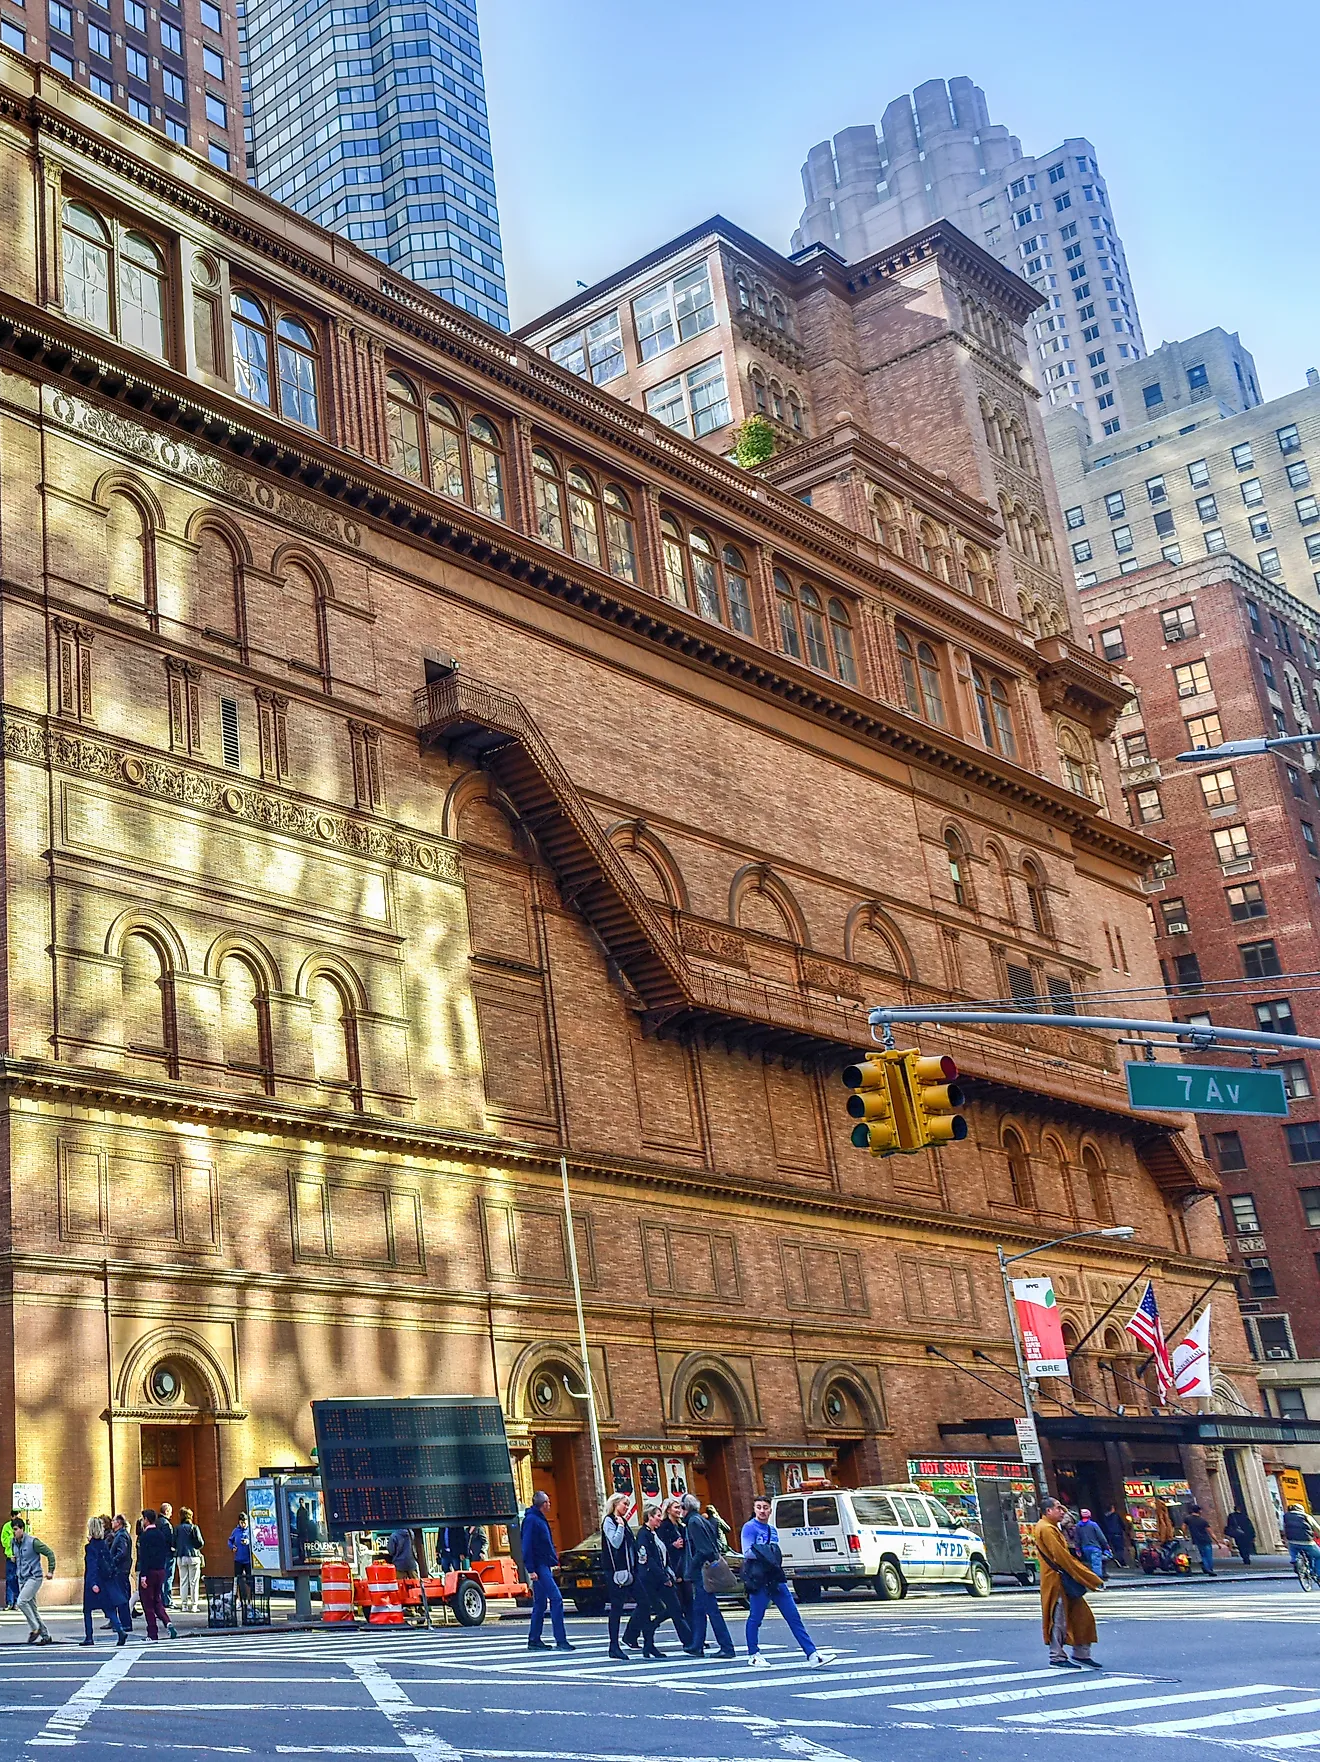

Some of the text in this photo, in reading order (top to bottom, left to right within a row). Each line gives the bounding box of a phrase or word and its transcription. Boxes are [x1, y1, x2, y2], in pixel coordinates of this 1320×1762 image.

[1176, 1075, 1240, 1104] 7 Av
[1035, 1364, 1060, 1372] CBRE
[920, 1462, 939, 1474] HOT
[334, 1484, 445, 1521] TIMES
[303, 1541, 339, 1551] FREQUENCY
[936, 1542, 964, 1558] NYPD
